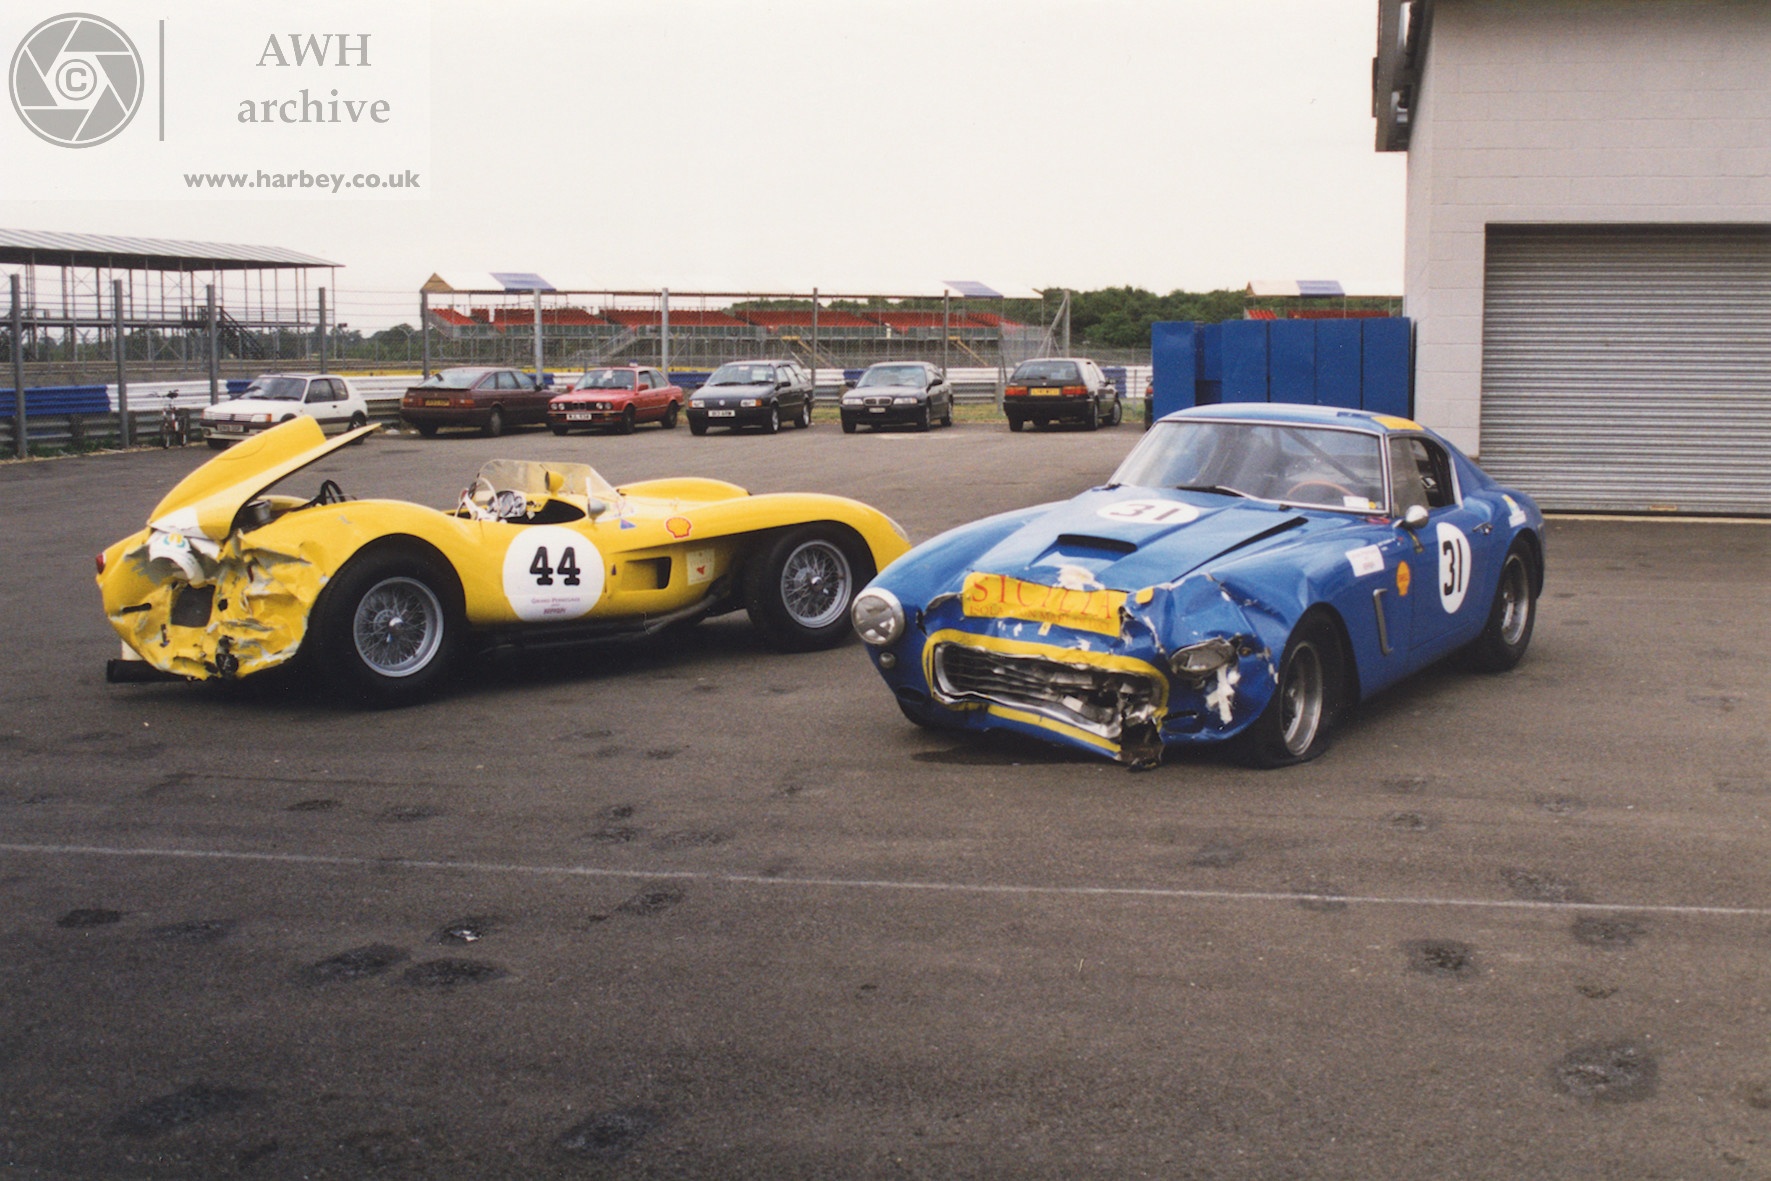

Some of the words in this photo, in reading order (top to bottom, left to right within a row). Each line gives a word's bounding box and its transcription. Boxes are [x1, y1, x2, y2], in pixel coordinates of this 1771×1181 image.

[1109, 503, 1181, 521] 31
[529, 546, 581, 586] 44
[1442, 538, 1463, 597] 31
